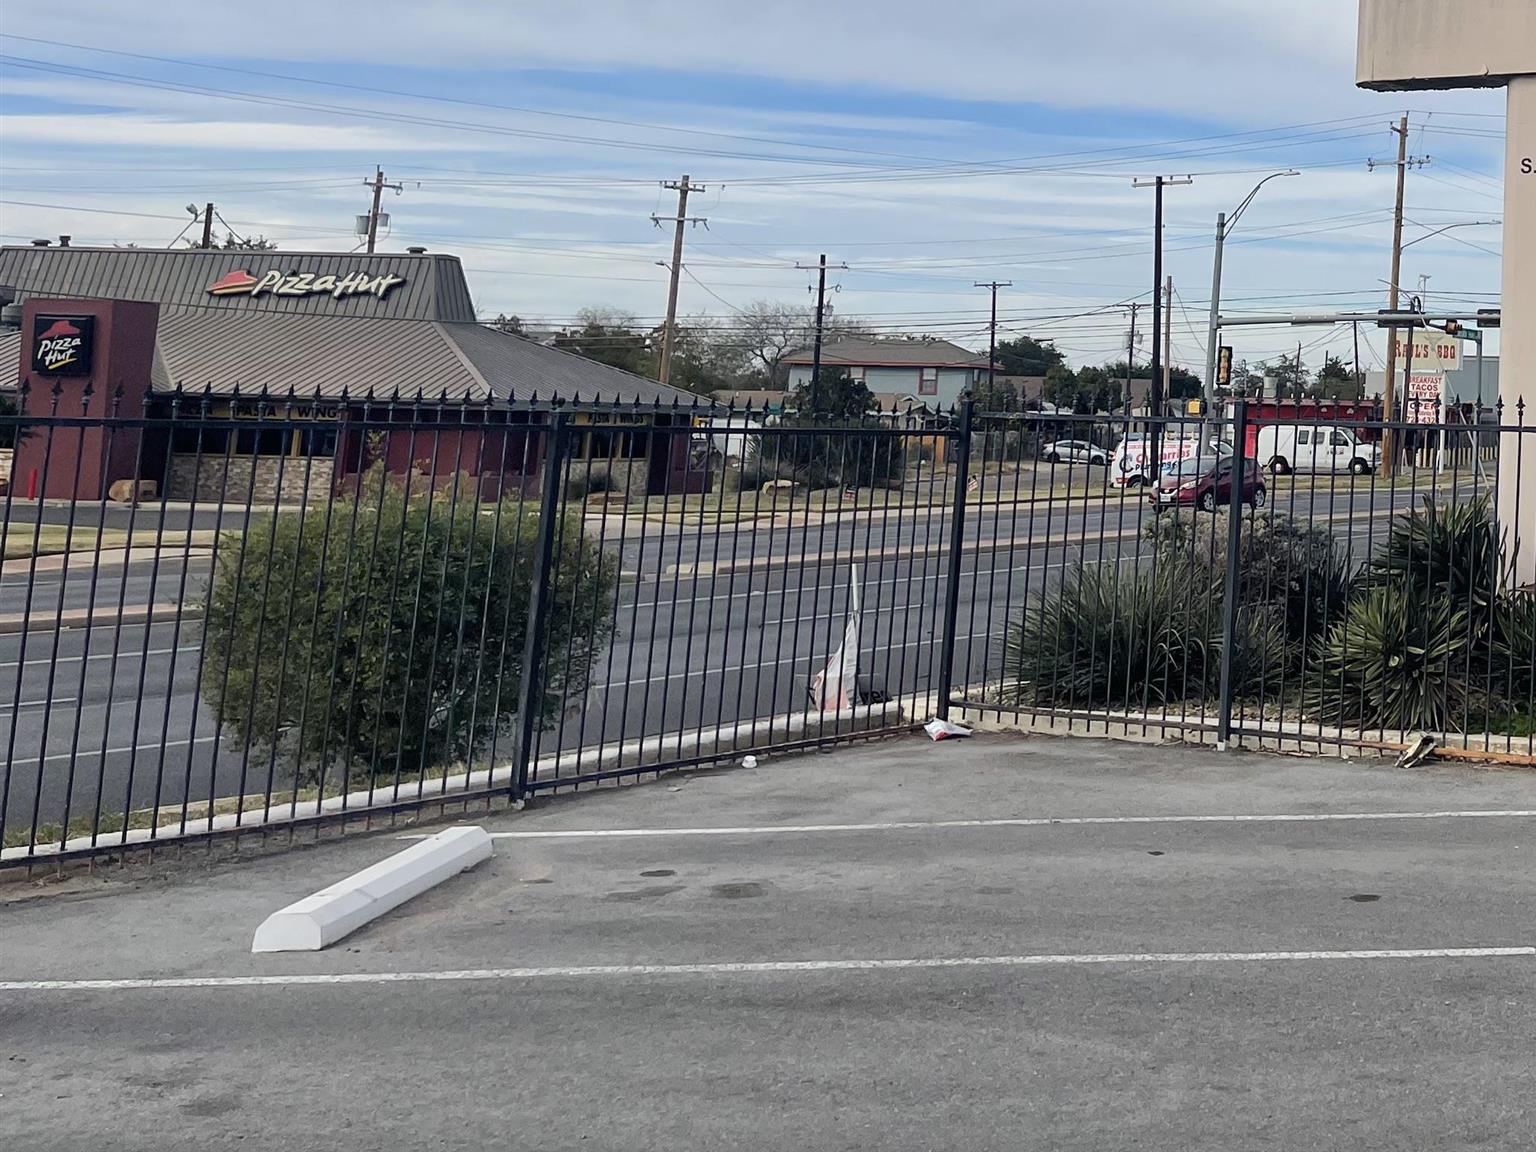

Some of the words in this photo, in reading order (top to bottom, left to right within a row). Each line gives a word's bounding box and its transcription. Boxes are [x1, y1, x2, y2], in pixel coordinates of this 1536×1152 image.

[252, 269, 335, 297] Pizza
[334, 269, 406, 299] Hut
[37, 335, 82, 360] Pizza
[45, 349, 76, 366] Hut
[1411, 383, 1438, 391] TACOS
